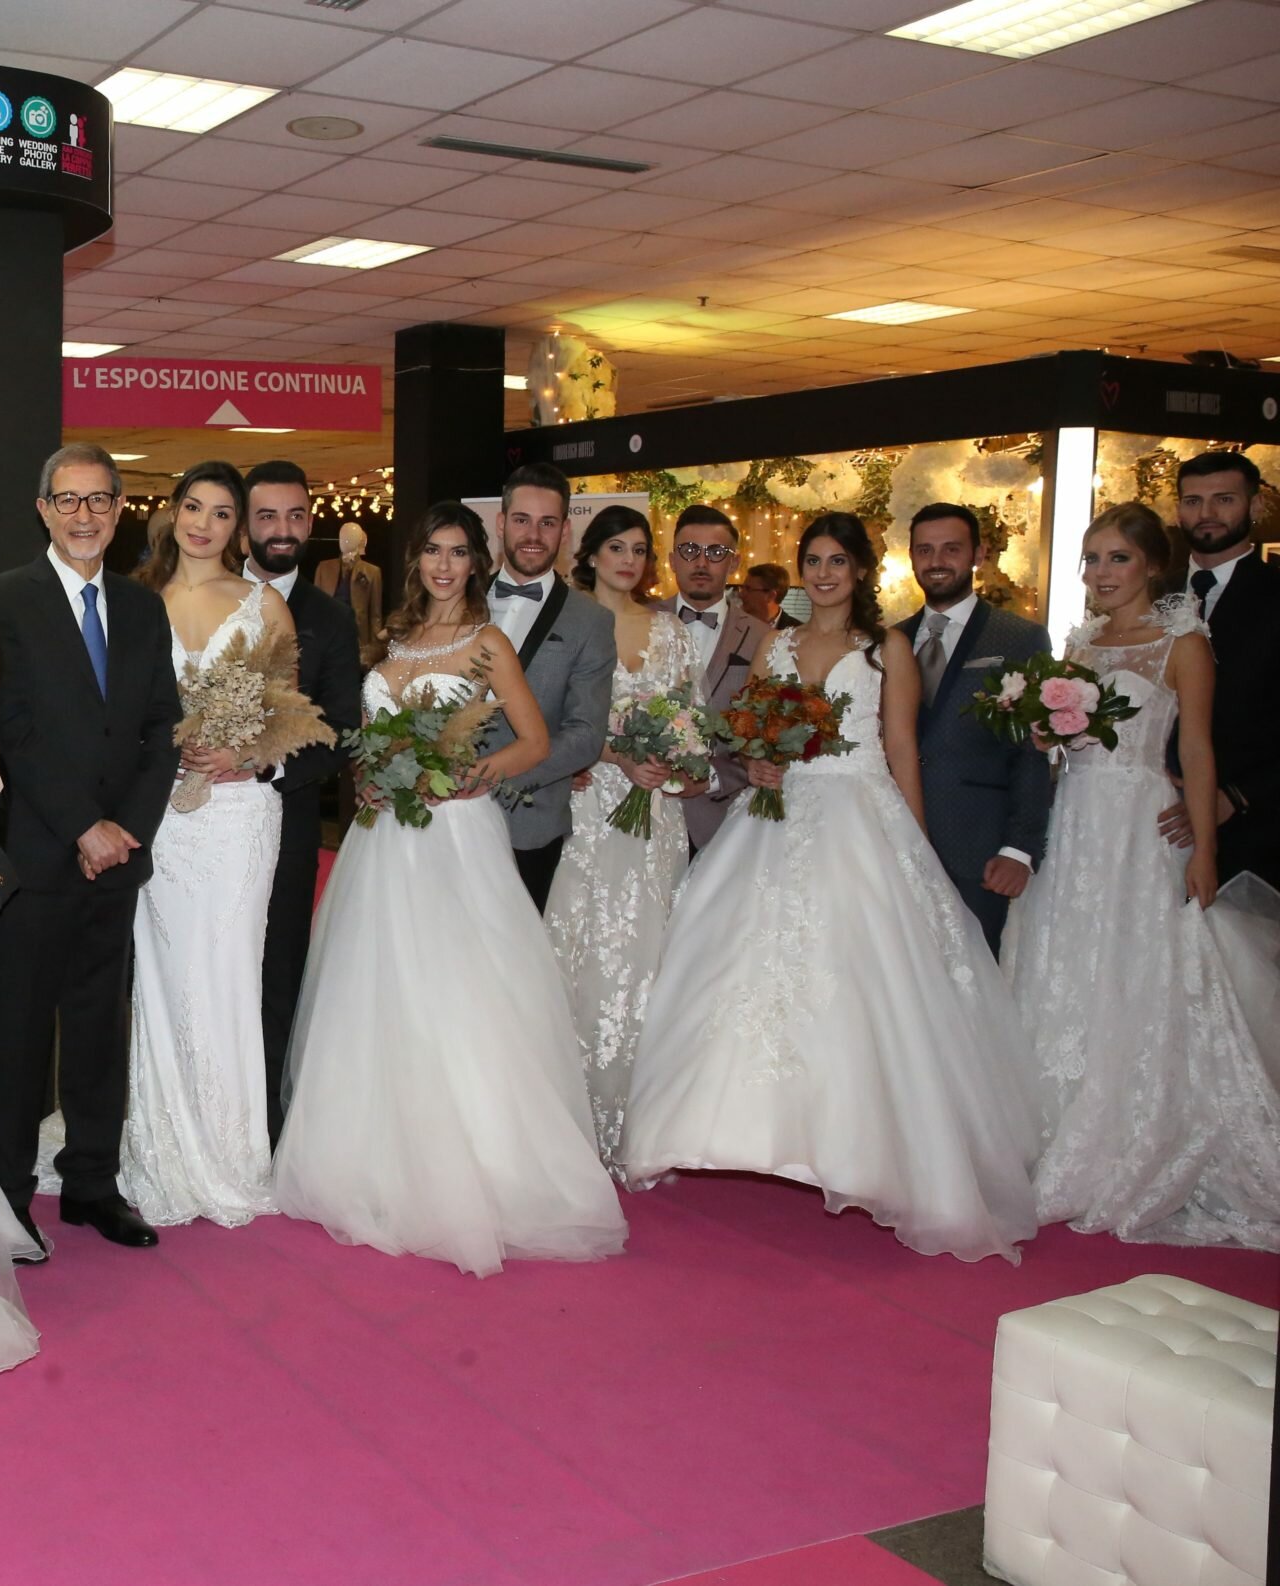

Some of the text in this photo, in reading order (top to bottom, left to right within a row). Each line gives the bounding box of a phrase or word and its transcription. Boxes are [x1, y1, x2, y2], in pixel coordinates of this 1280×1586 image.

[18, 139, 58, 154] WEDDING
[24, 148, 53, 162] PHOTO
[20, 158, 57, 171] GALLERY
[95, 367, 249, 392] ESPOSIZIONE
[254, 371, 367, 395] CONTINUA
